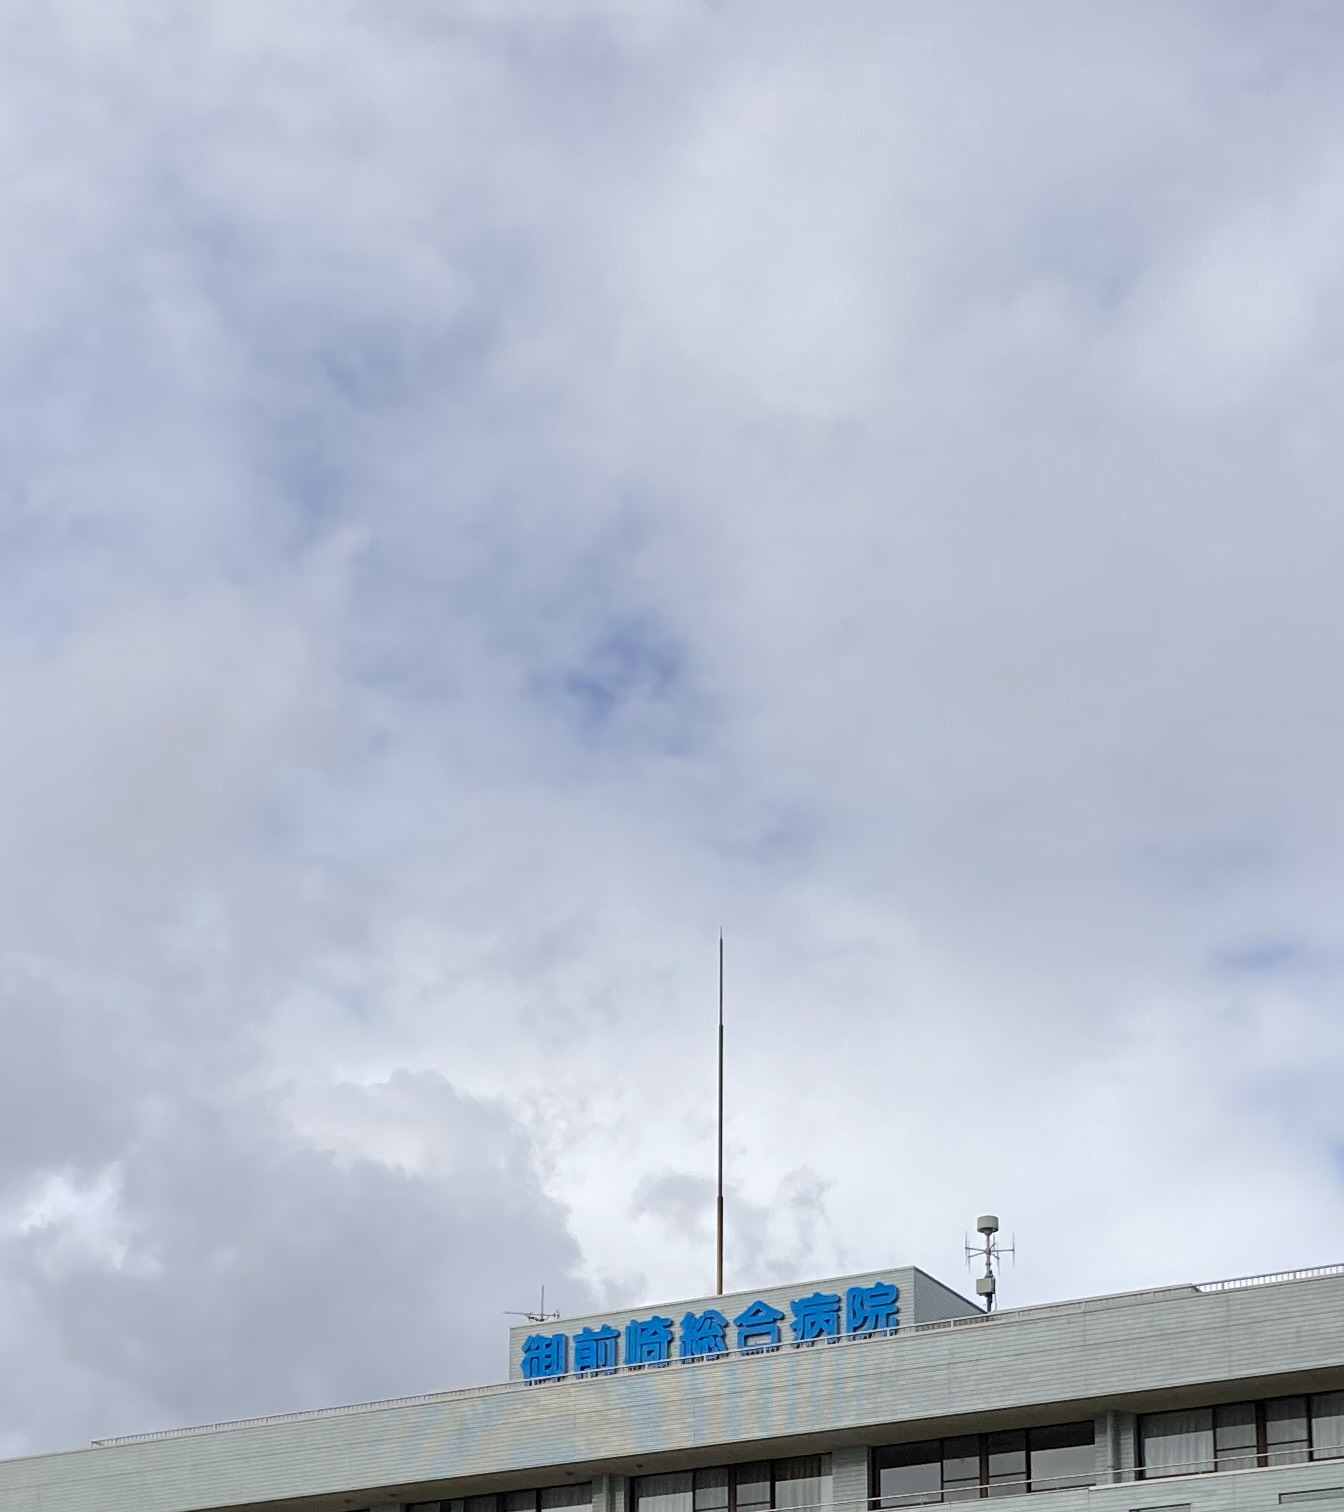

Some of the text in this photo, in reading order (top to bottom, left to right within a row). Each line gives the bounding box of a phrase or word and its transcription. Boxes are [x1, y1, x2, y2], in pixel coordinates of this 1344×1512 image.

[520, 1281, 900, 1384] 御前崎総合病院
